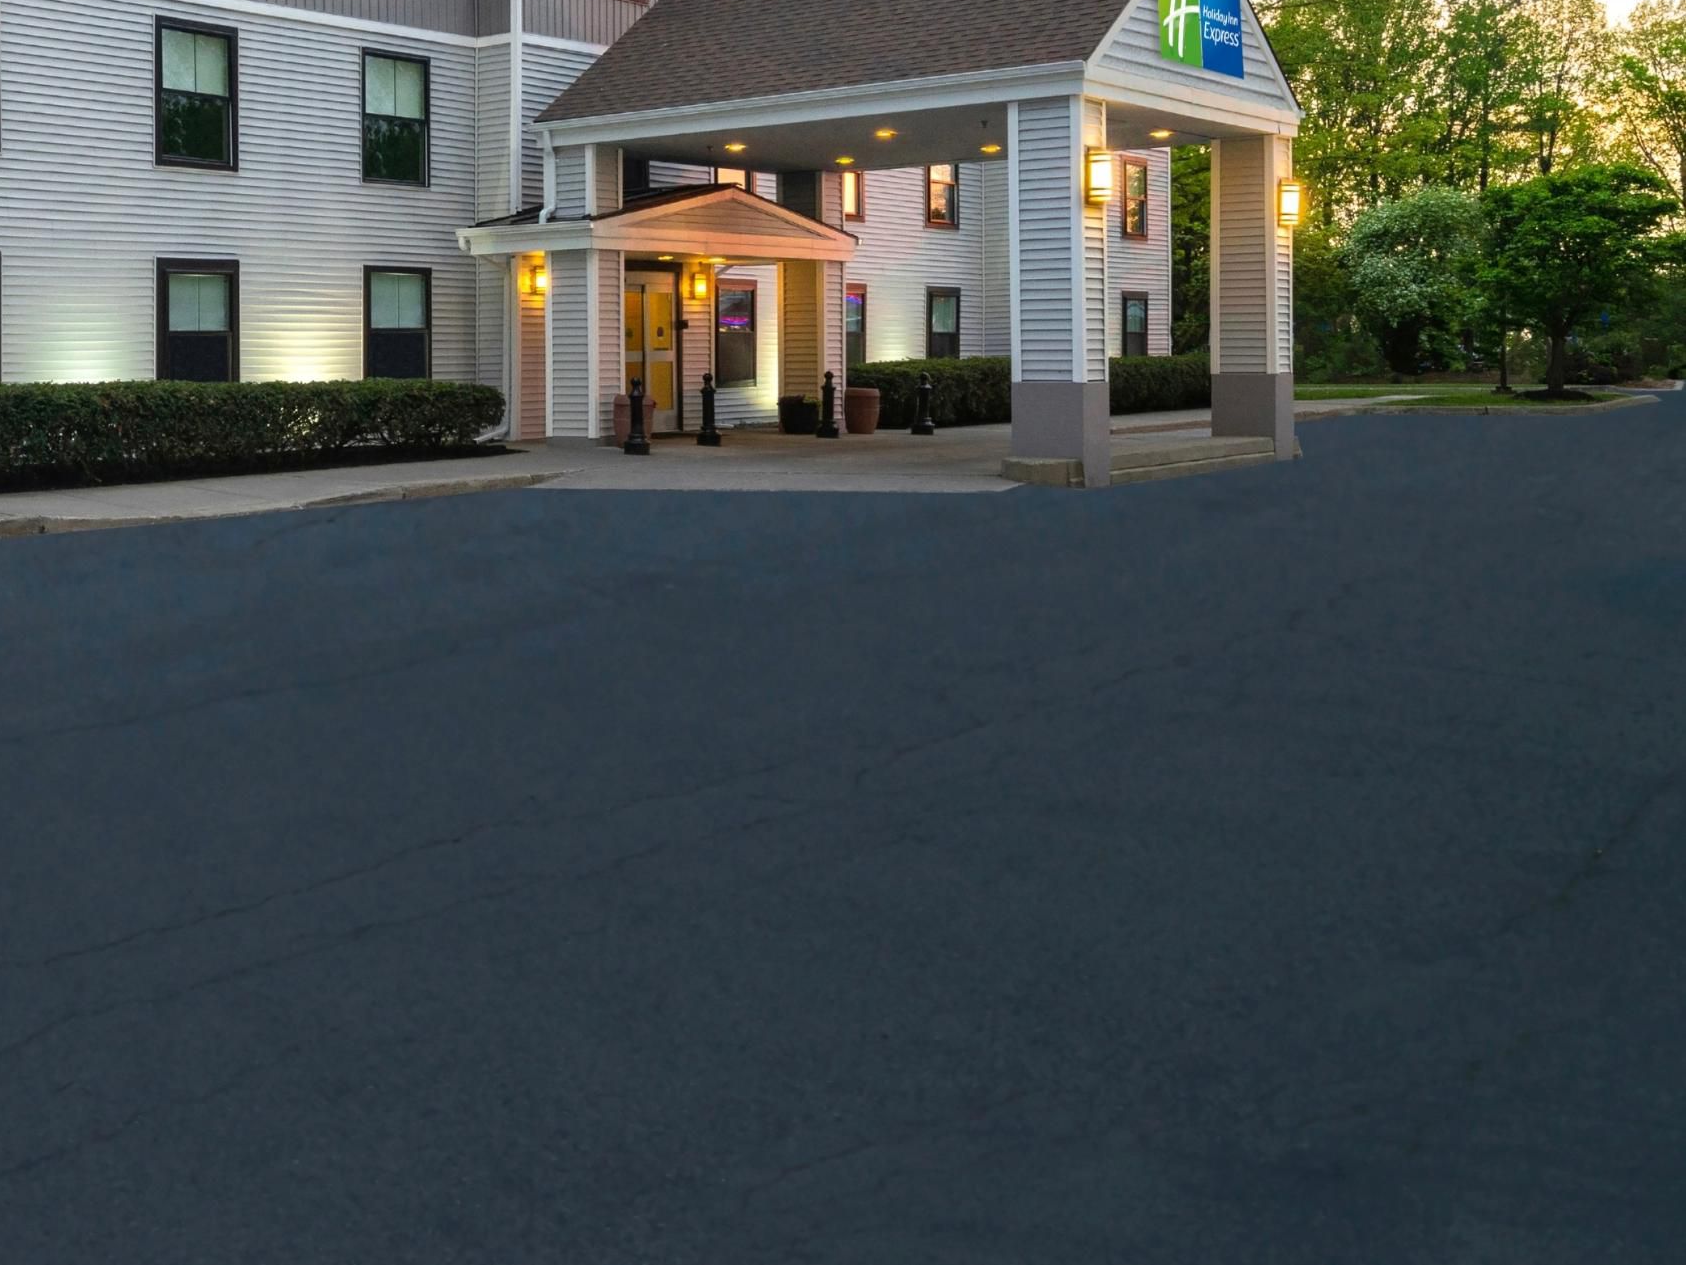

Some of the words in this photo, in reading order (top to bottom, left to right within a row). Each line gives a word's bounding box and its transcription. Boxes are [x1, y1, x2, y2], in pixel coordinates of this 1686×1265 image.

[1203, 4, 1227, 26] Holiday
[1227, 11, 1239, 26] Inn
[1204, 21, 1239, 47] Express
